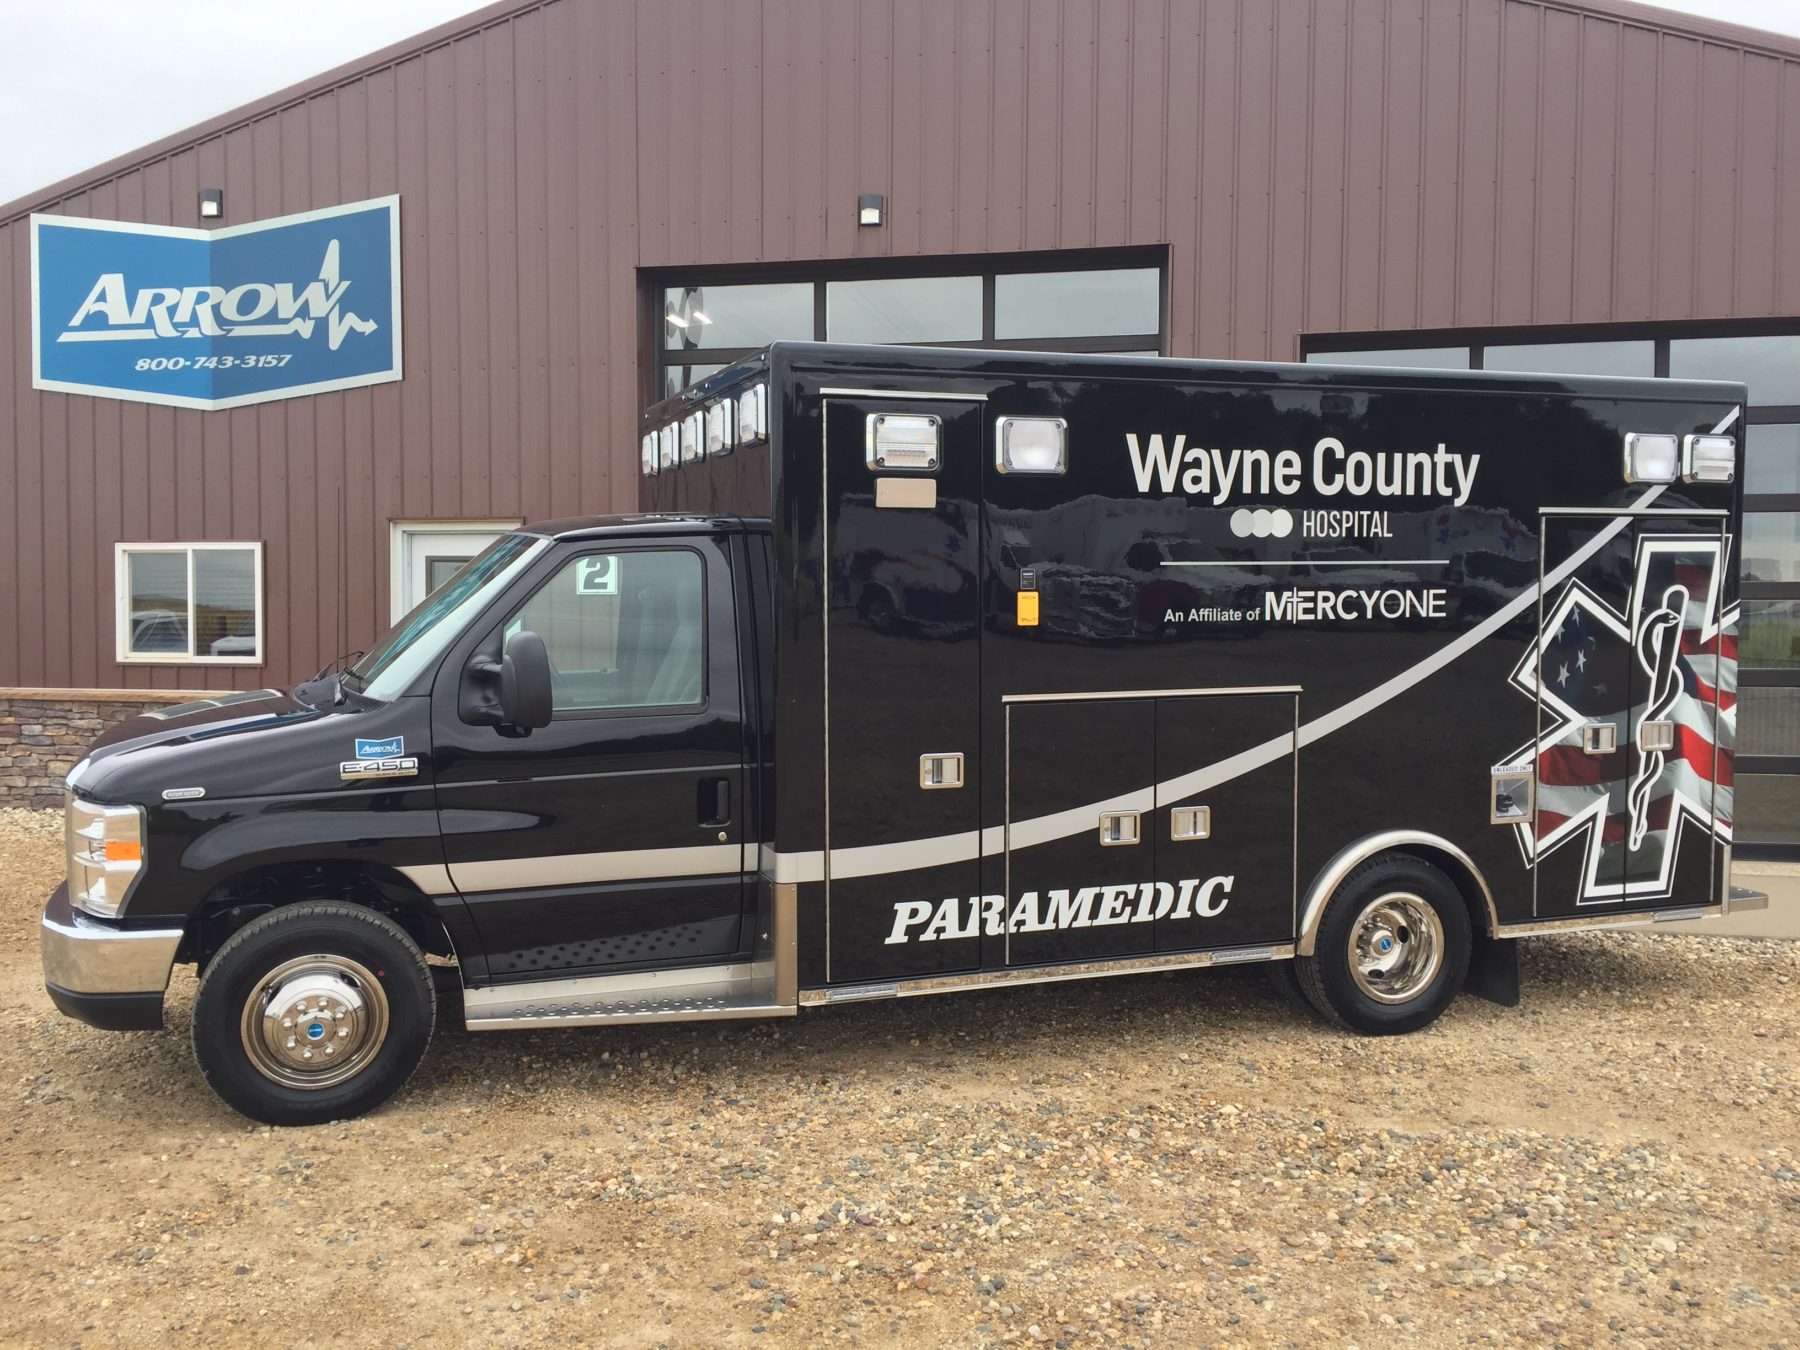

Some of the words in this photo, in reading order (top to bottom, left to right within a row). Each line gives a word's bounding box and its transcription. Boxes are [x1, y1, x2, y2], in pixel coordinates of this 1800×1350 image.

[67, 271, 352, 338] ARROW
[135, 354, 293, 371] 800-743-3157
[1125, 433, 1302, 506] Wayne
[1312, 437, 1480, 507] County
[1302, 510, 1393, 538] HOSPITAL
[583, 556, 610, 590] 2
[1164, 609, 1184, 623] An
[1188, 607, 1243, 622] Affiliate
[1245, 607, 1260, 621] of
[343, 760, 416, 773] E-450
[884, 875, 1235, 945] PARAMEDIC
